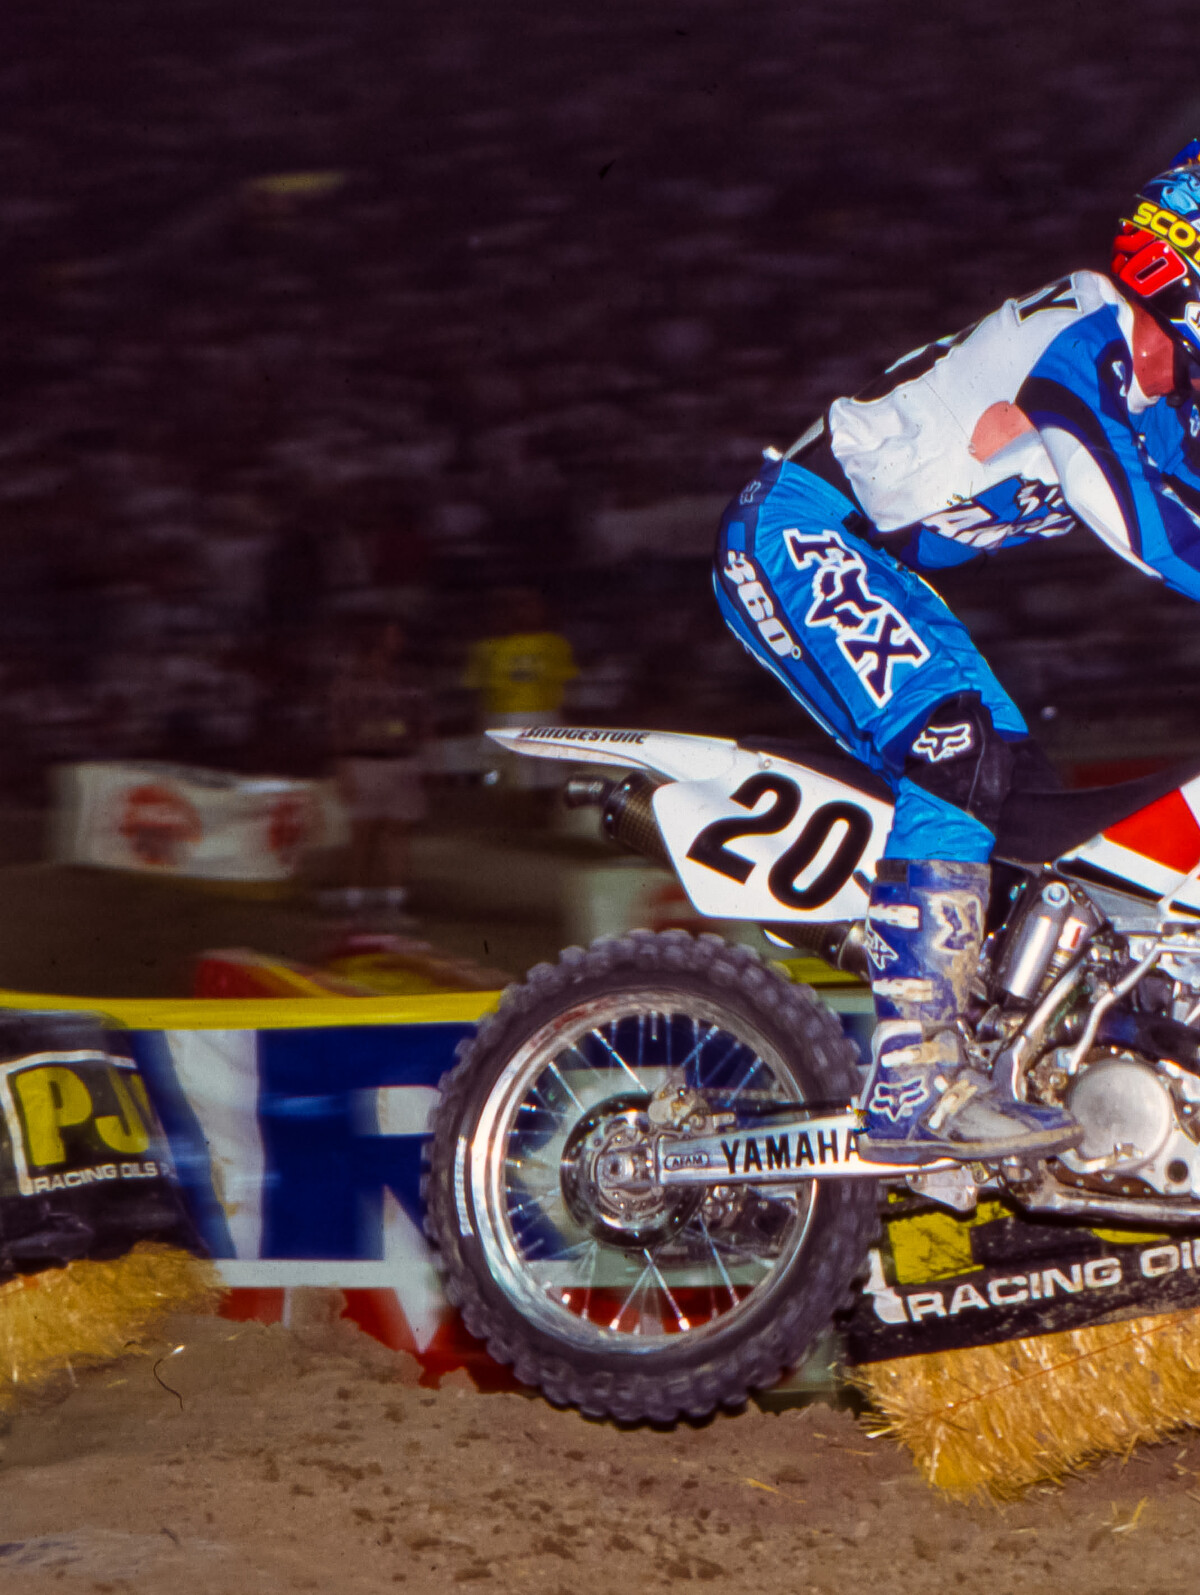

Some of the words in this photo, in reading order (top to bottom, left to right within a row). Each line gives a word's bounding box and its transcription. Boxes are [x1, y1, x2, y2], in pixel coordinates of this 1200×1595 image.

[686, 771, 873, 911] 20
[16, 1066, 151, 1167] PJ
[33, 1163, 118, 1195] RACING
[120, 1161, 159, 1179] OILS
[720, 1128, 860, 1175] YAMAHA
[907, 1256, 1123, 1324] RACING
